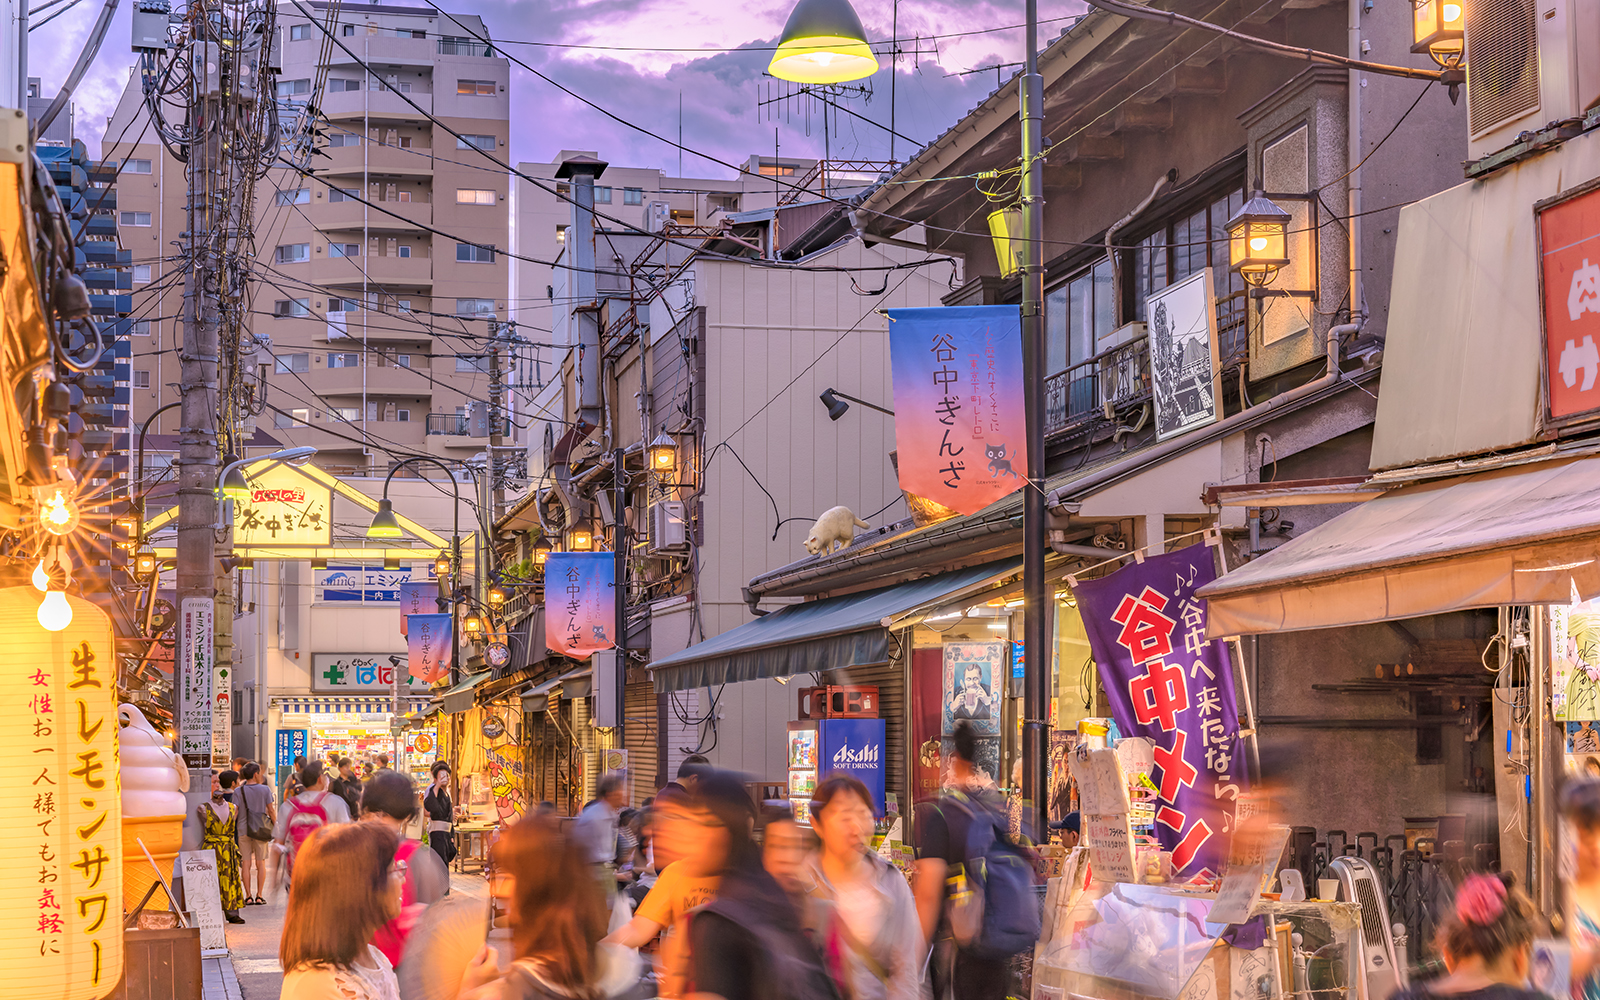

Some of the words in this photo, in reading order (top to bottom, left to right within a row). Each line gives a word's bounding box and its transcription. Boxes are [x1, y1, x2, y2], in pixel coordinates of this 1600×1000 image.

[930, 333, 965, 489] 谷中ぎんざ
[984, 326, 1000, 432] 人と歴史がすぐそこに
[240, 499, 323, 538] 谷中ぎんざ
[252, 487, 305, 503] ひぐらしの里
[364, 574, 412, 588] エミング
[565, 566, 581, 649] 谷中ぎんざ
[195, 610, 206, 709] エミング千駄木クリニック
[421, 622, 432, 675] 谷中ぎんざ
[833, 744, 879, 763] Asahi
[28, 668, 64, 957] 女性お一人様でもお気軽に
[69, 640, 108, 984] 生レモンサワー
